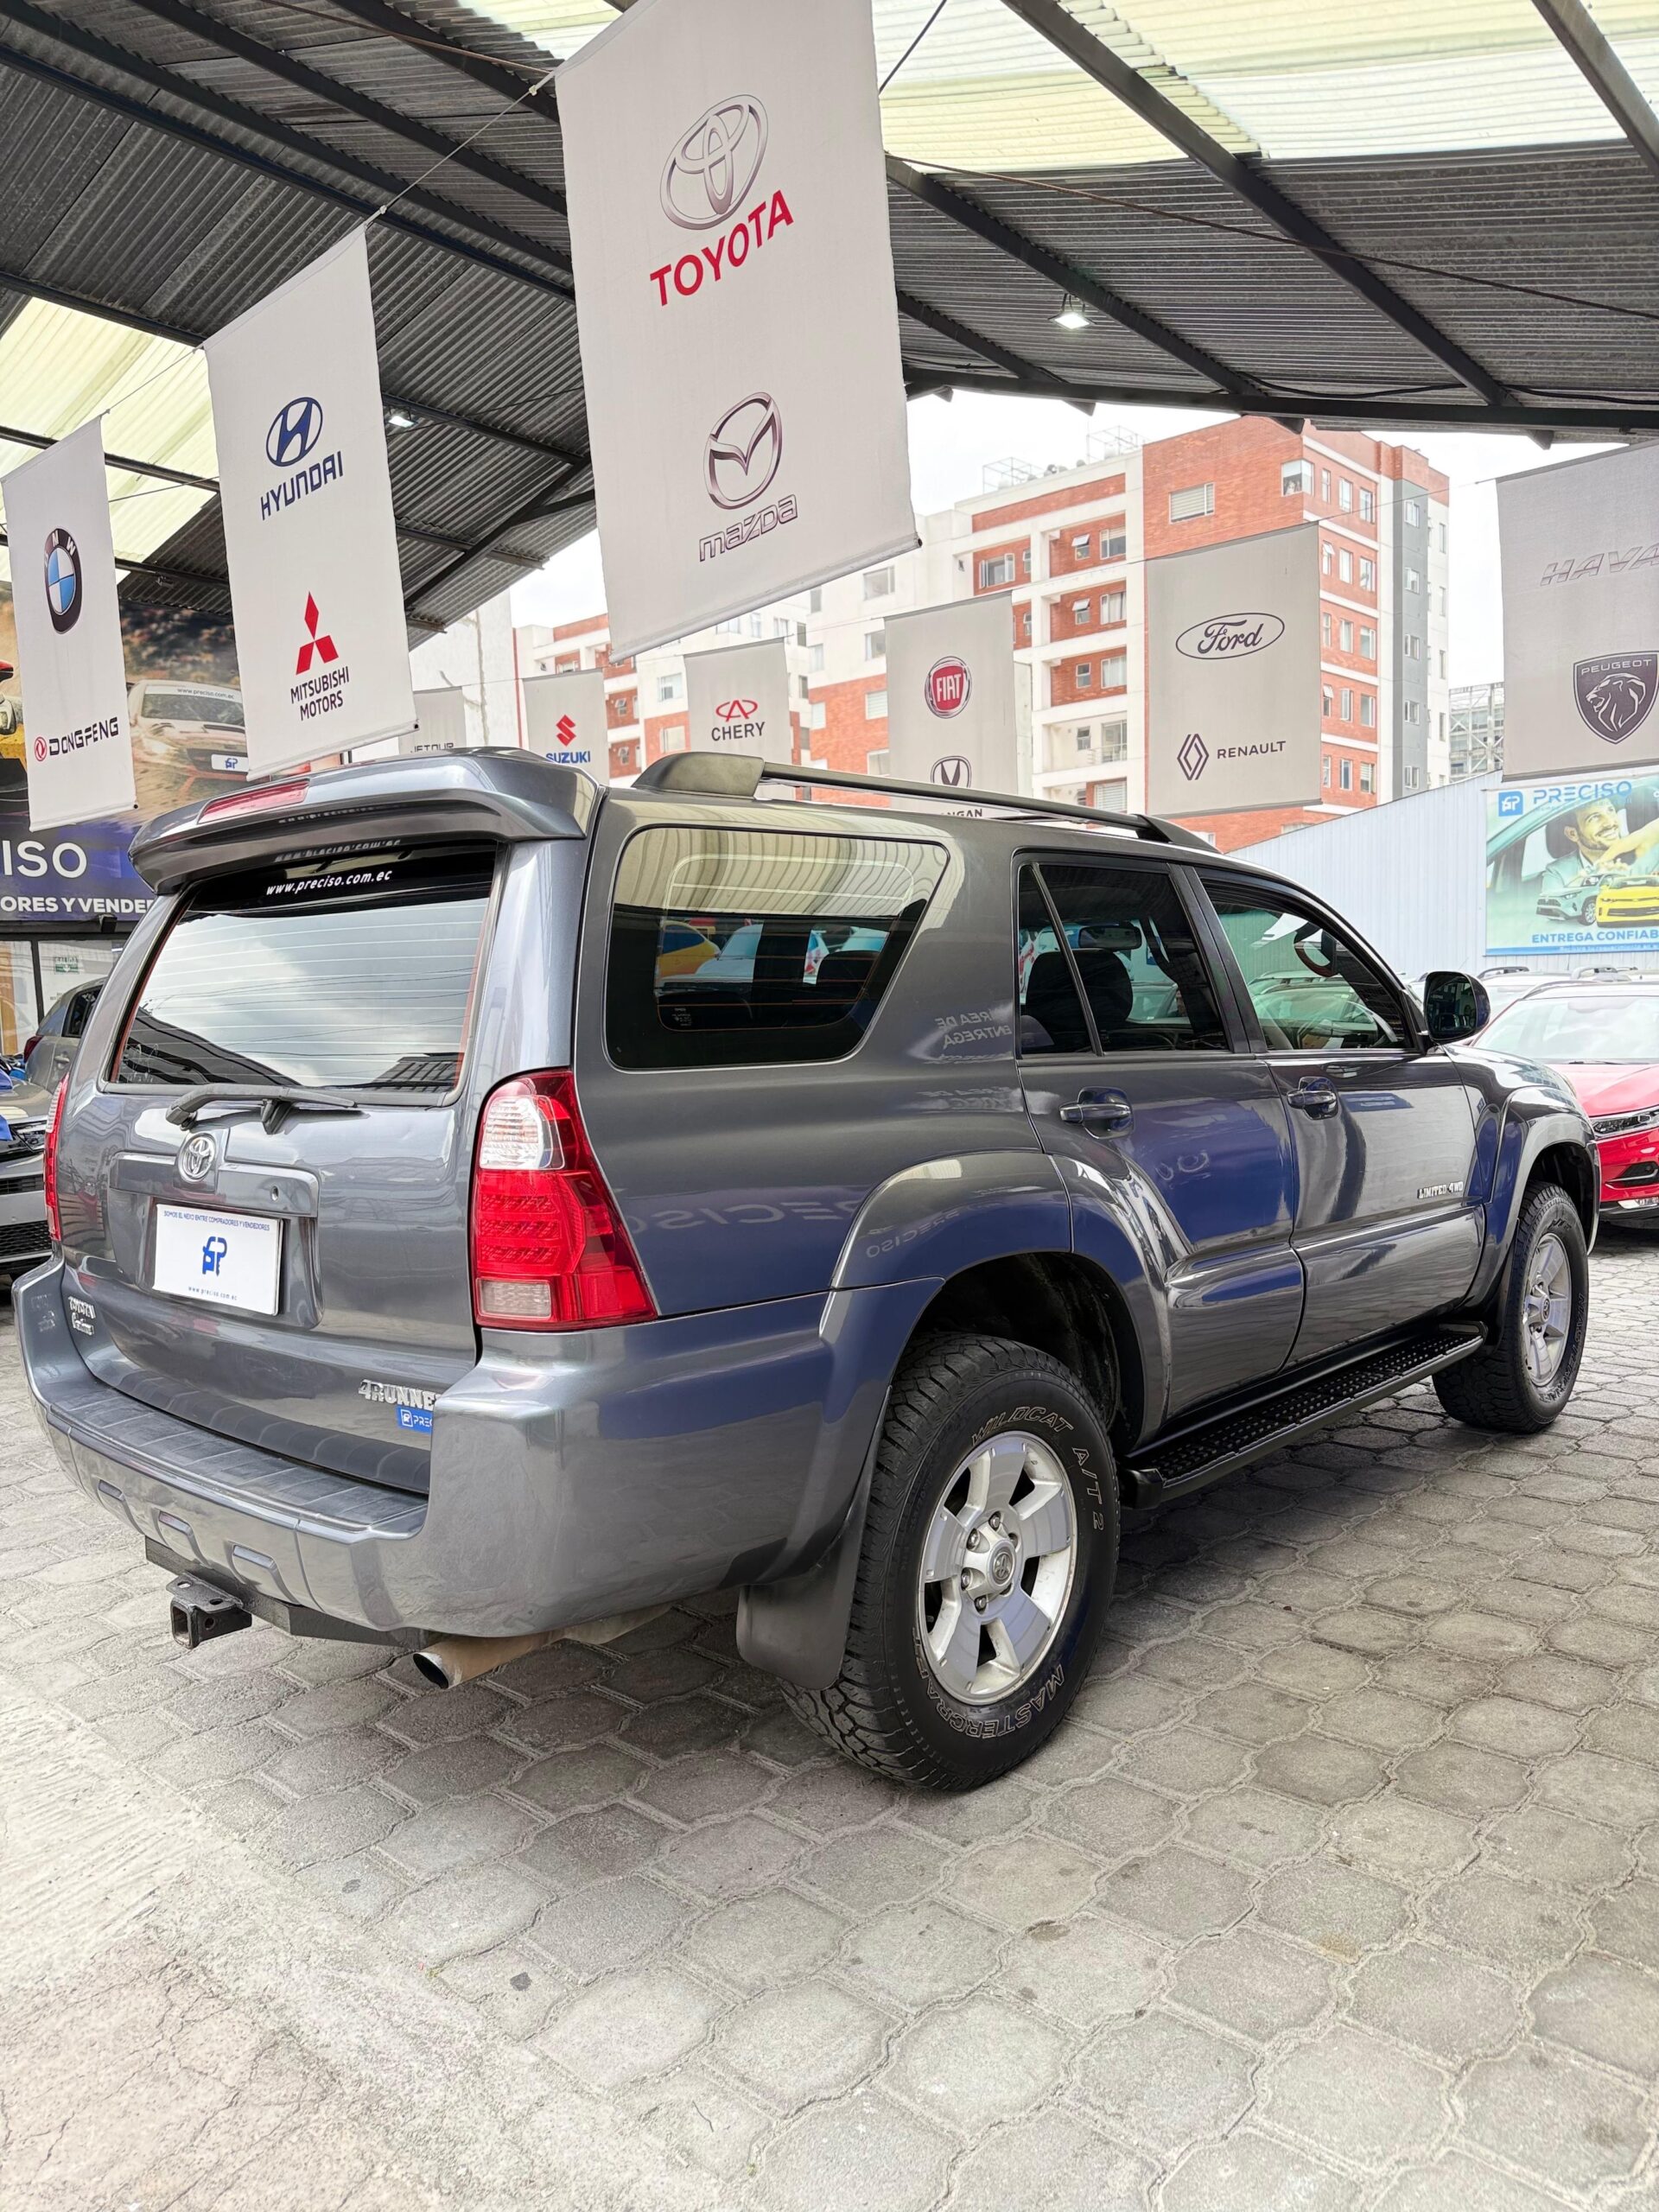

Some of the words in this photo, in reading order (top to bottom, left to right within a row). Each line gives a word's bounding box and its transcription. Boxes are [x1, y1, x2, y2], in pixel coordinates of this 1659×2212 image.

[650, 189, 794, 306] TOYOTA
[260, 451, 344, 520] HYUNDAI
[1198, 620, 1264, 654] Ford
[1581, 658, 1652, 676] PEUGEOT
[290, 666, 350, 704] MITSUBISHI
[936, 673, 962, 702] FIAT
[300, 690, 344, 721] MOTORS
[48, 716, 119, 756] DONGFENG
[711, 721, 766, 742] CHERY
[545, 751, 591, 764] SUZUKI
[1217, 741, 1287, 760] RENAULT
[1533, 780, 1632, 804] PRECISO
[2, 840, 87, 879] ISO
[265, 869, 393, 895] www.preciso.com.ec
[0, 896, 59, 912] ORES
[61, 897, 76, 912] Y
[1532, 932, 1594, 944] ENTREGA
[1418, 1184, 1447, 1199] LIMITED
[1447, 1181, 1464, 1193] 4WD
[195, 1214, 208, 1223] ENTRE
[208, 1216, 238, 1227] COMPRADORES
[242, 1220, 270, 1231] VENDEDORES
[358, 1379, 442, 1412] 4RUNNE
[971, 1406, 1074, 1446] WILDCAT
[1071, 1447, 1103, 1505] A/T
[1092, 1511, 1104, 1531] 2
